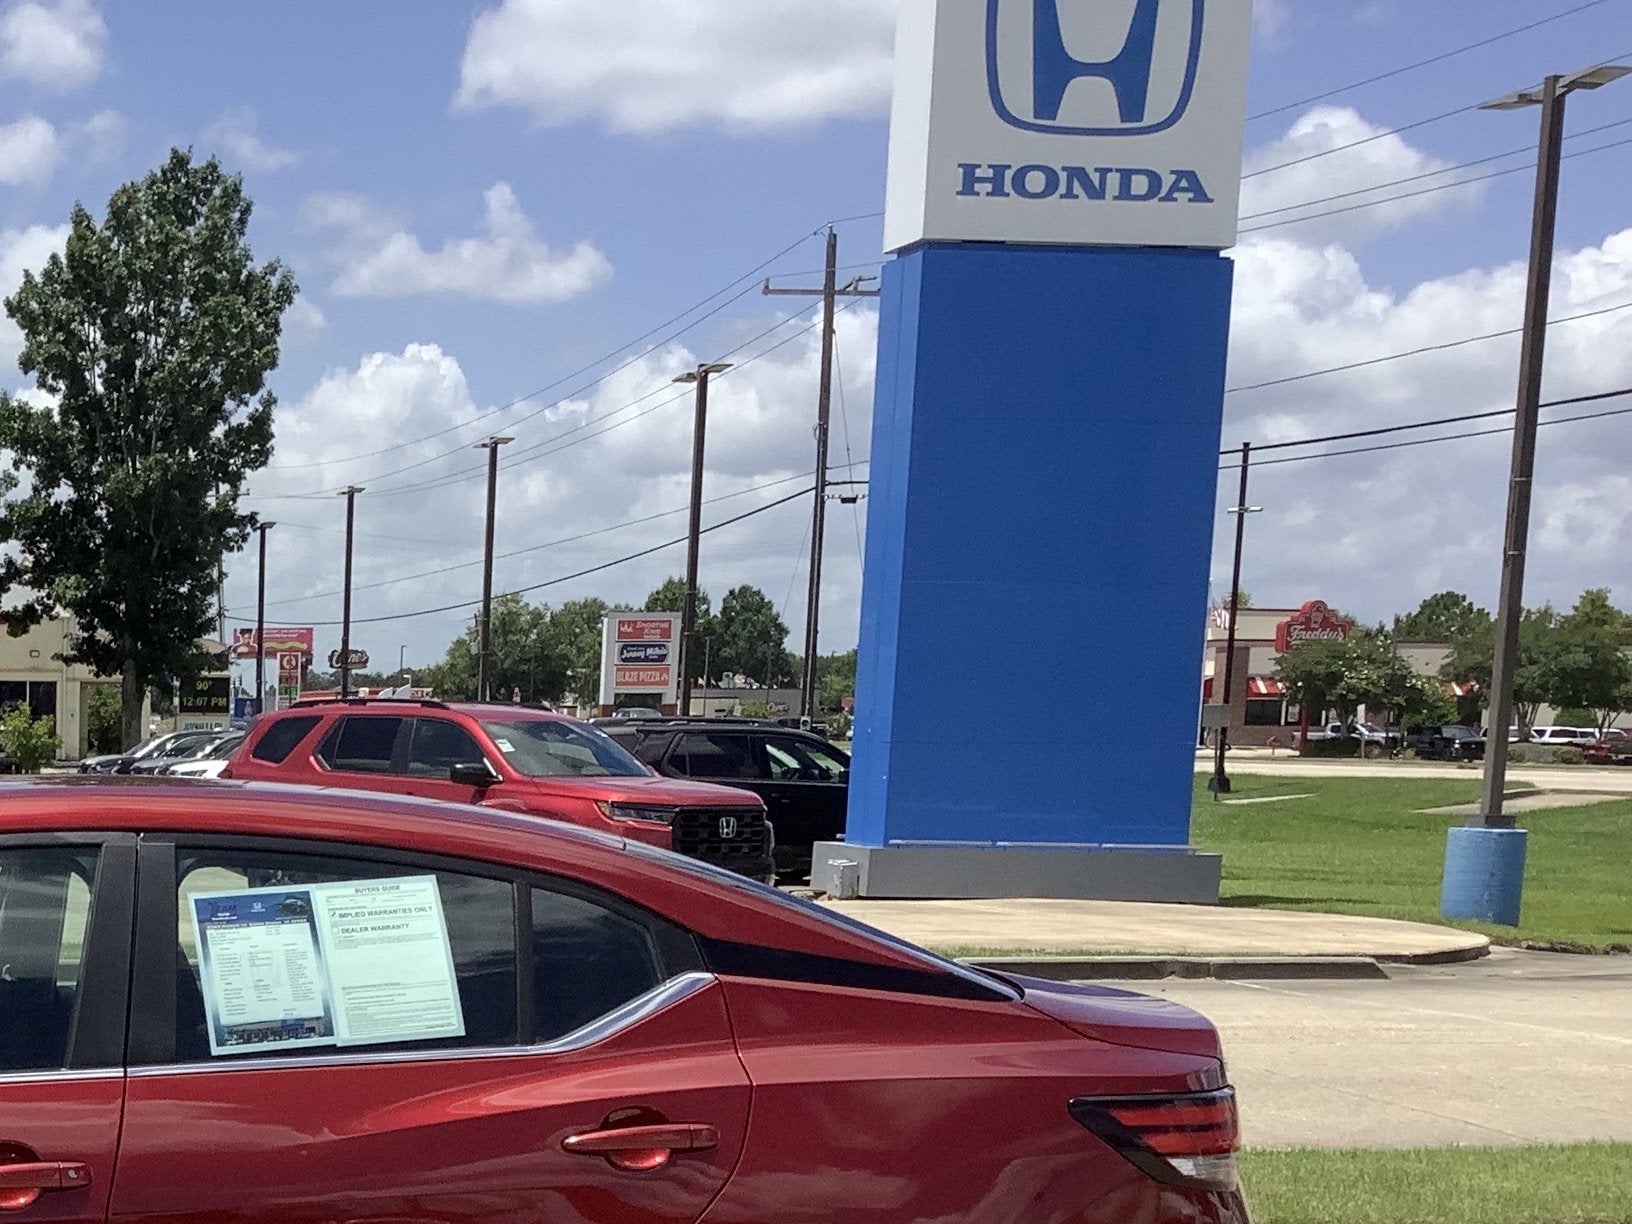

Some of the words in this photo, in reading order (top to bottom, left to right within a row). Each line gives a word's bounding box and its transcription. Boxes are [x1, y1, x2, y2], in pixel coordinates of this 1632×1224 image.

[956, 162, 1215, 204] HONDA
[331, 648, 368, 668] Cne's
[639, 671, 660, 682] PIZZA
[210, 696, 227, 707] PM
[354, 886, 380, 894] BUYERS
[381, 884, 400, 892] GUIDE
[338, 911, 366, 919] IMPLIED
[367, 907, 413, 917] WARRANTIES
[414, 905, 433, 913] ONLY
[341, 927, 370, 935] DEALER
[369, 923, 410, 932] WARRANTY
